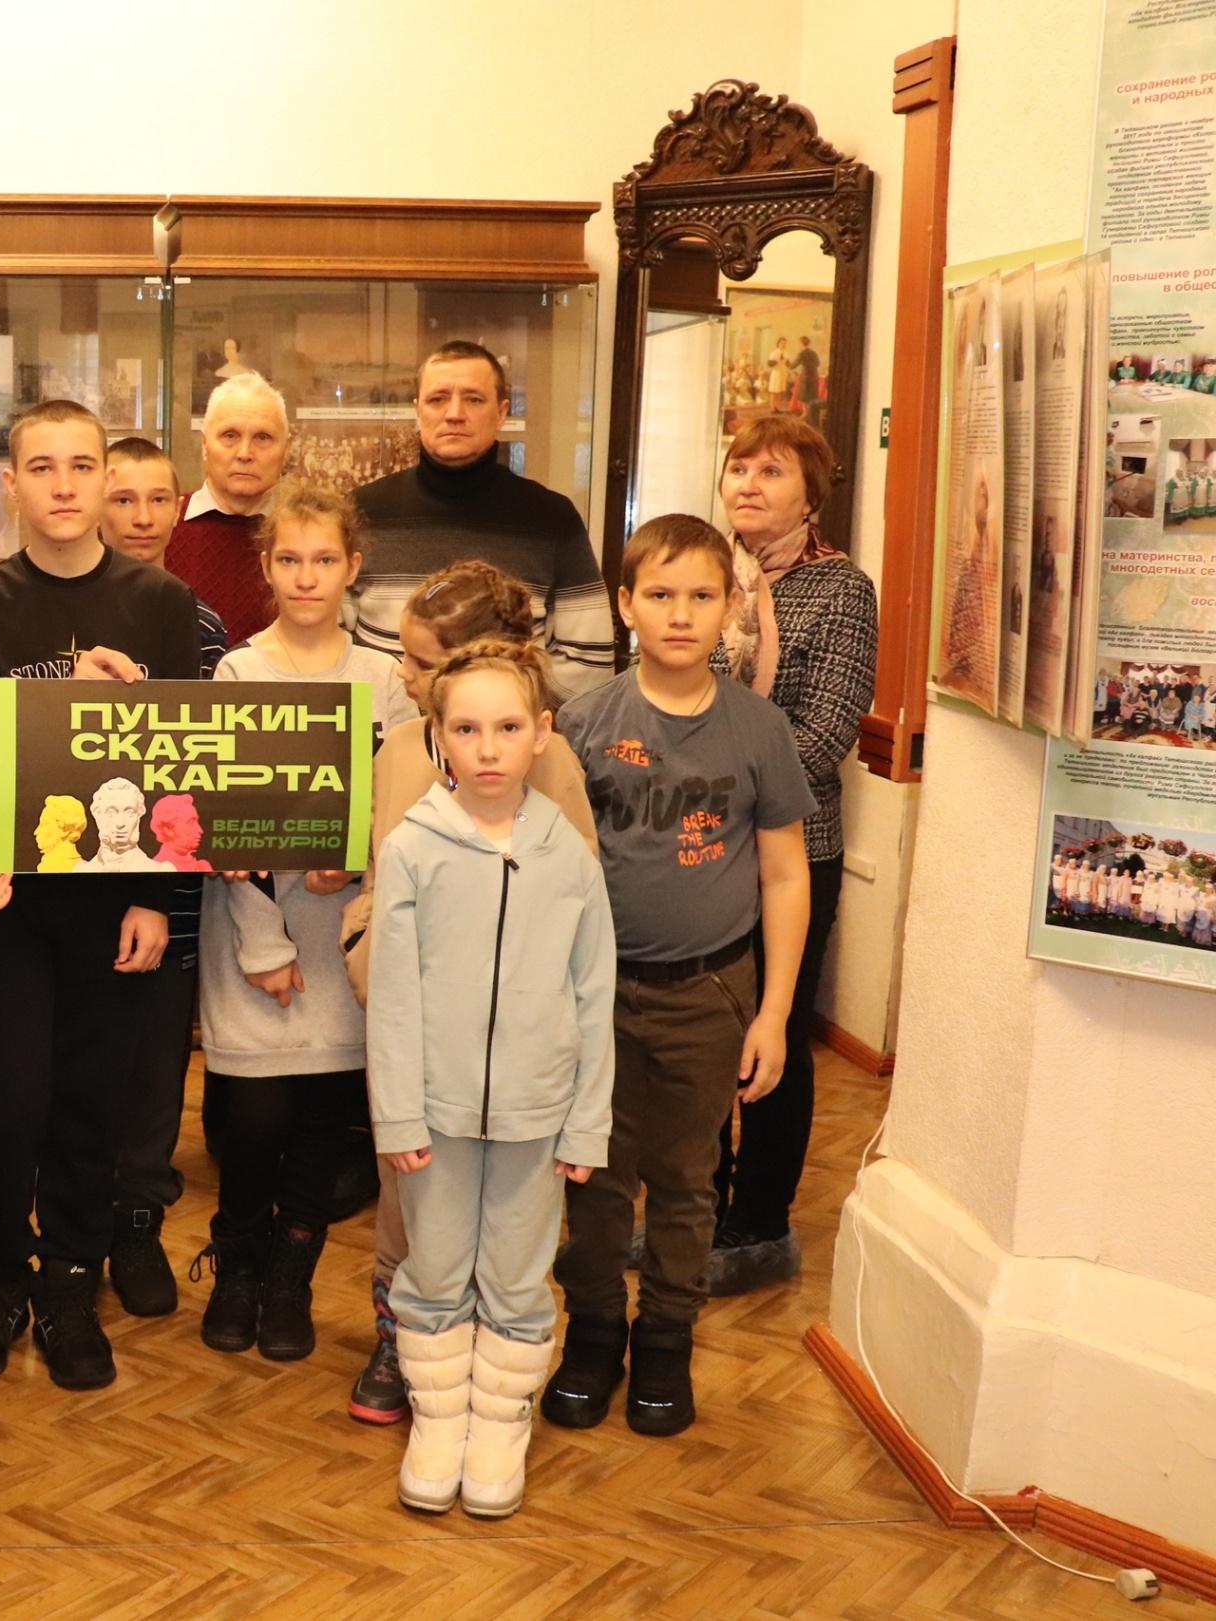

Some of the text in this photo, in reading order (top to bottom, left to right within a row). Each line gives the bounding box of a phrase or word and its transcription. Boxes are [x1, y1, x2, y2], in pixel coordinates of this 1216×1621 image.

[1117, 75, 1196, 94] сохранение
[1144, 86, 1214, 104] народных
[1113, 269, 1190, 282] повышение
[1163, 283, 1171, 292] в
[1119, 551, 1206, 563] материнства,
[1111, 563, 1196, 575] многодетных
[70, 702, 347, 732] ПУШКИН
[70, 733, 236, 761] СКАЯ
[143, 764, 345, 792] КАРТА
[212, 818, 343, 833] ВЕДИ СЕБЯ
[682, 810, 722, 833] BREAK
[211, 835, 342, 850] КУЛЬТУРНО
[677, 831, 704, 847] THE
